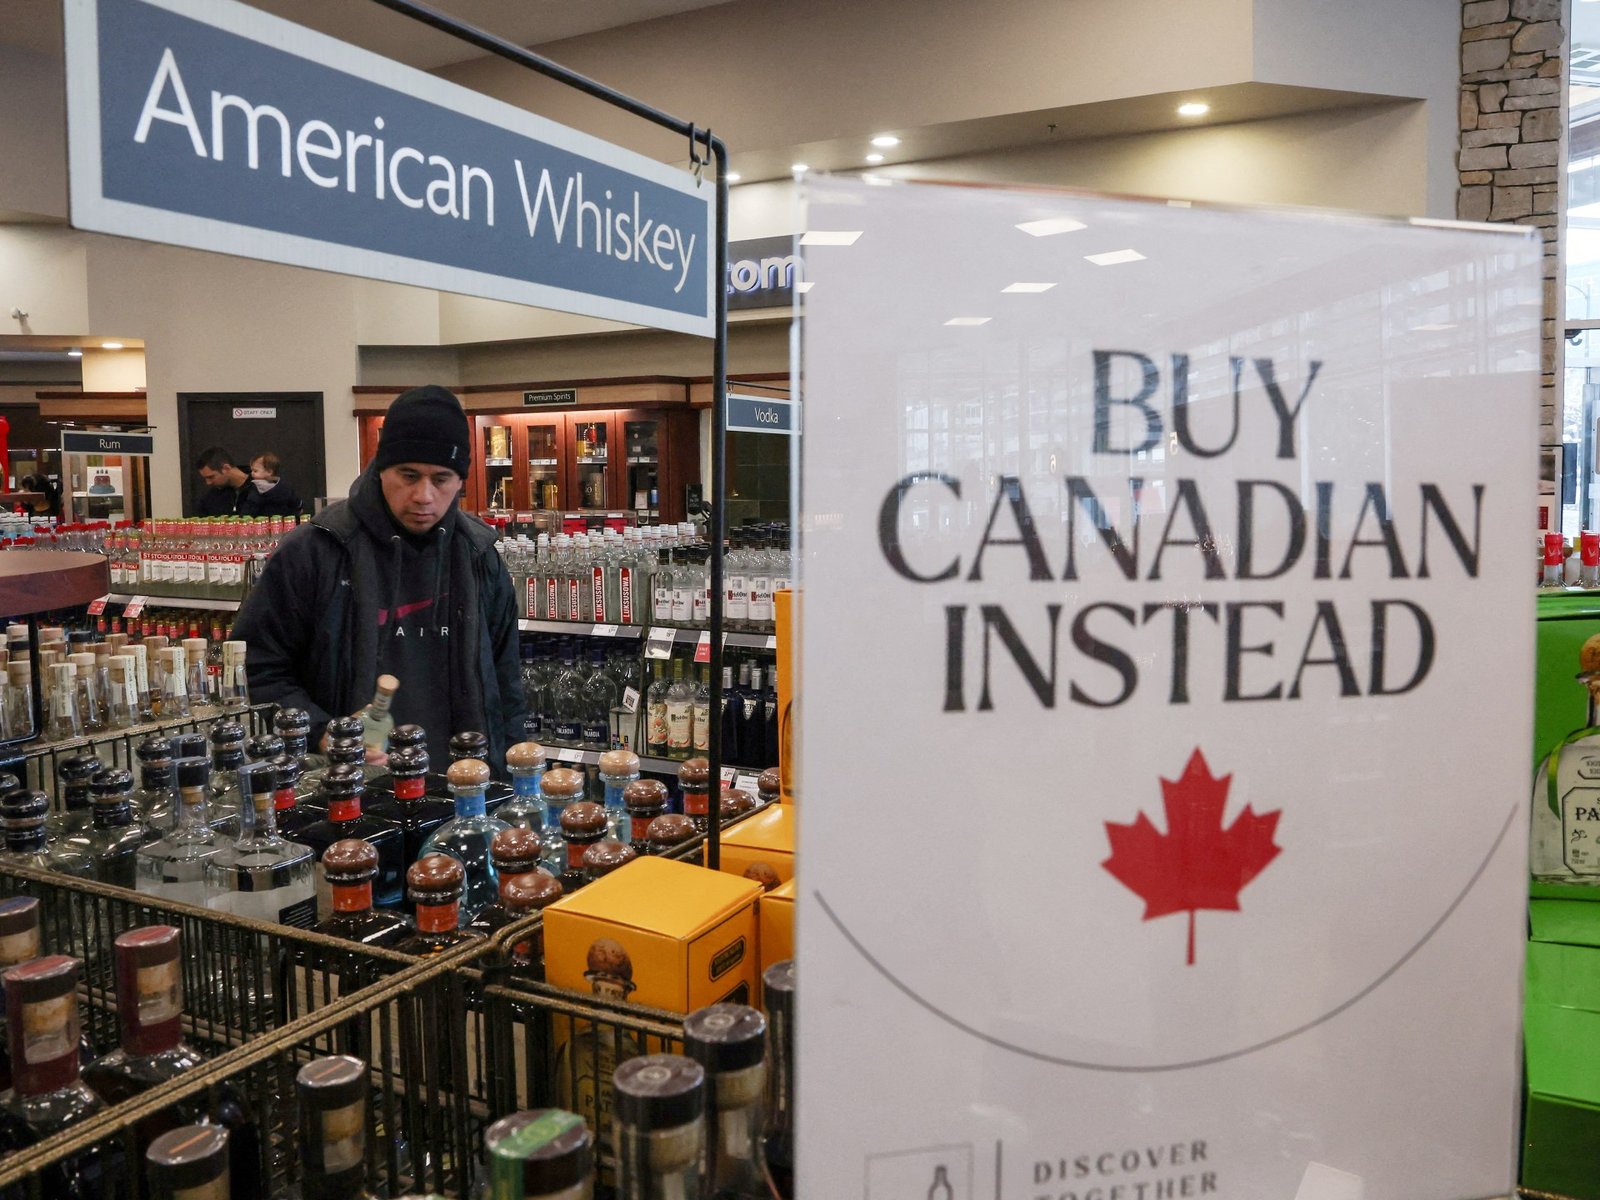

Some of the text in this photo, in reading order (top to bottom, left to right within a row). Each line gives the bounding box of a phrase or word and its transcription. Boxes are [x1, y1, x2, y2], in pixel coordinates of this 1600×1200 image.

[134, 47, 695, 293] American Whiskey
[727, 255, 805, 294] om
[528, 392, 571, 402] Premium Spirits
[754, 407, 779, 424] Vodka
[1090, 349, 1323, 459] BUY
[99, 438, 121, 449] Rum
[878, 472, 1485, 583] CANADIAN
[595, 575, 603, 617] LUKSUSOWA
[622, 576, 630, 618] LUKSUSOWA
[396, 626, 449, 637] AIR
[943, 598, 1436, 713] INSTEAD
[1033, 1140, 1208, 1184] DISCOVER
[1034, 1171, 1217, 1200] GETHER
